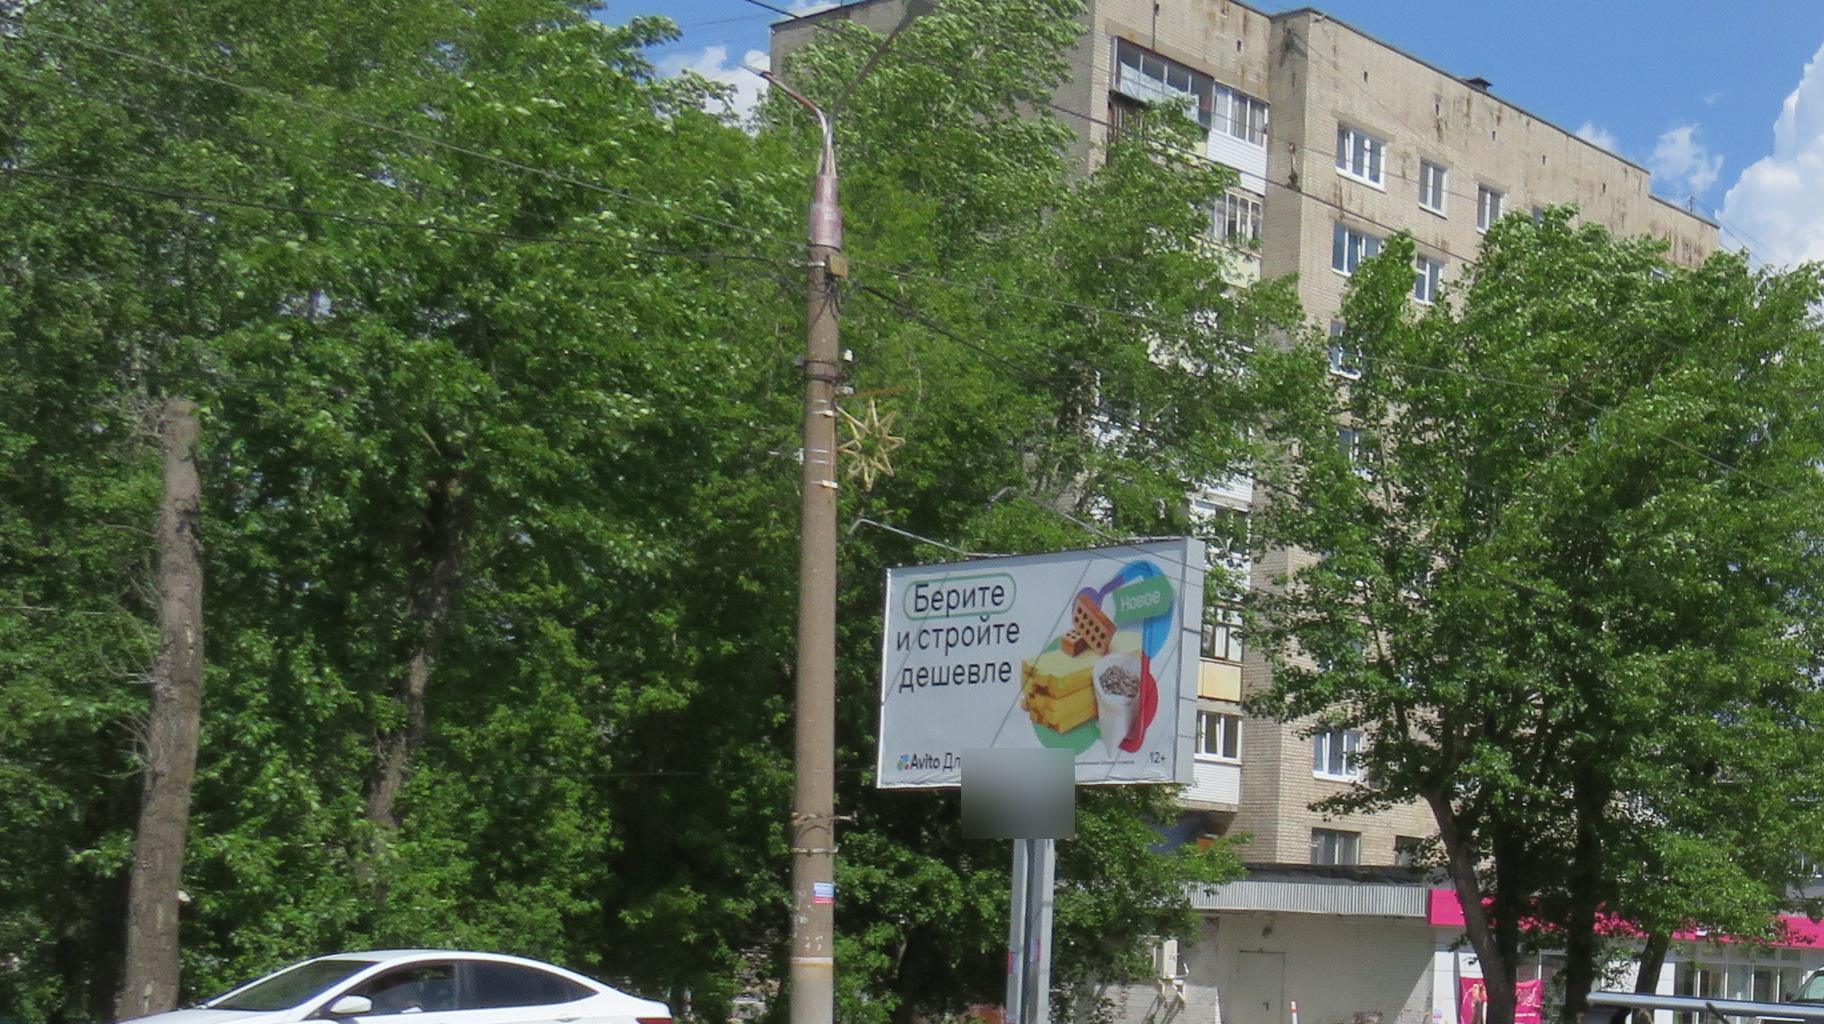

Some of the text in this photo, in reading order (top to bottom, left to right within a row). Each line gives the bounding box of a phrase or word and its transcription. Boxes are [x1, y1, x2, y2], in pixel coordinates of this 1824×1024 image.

[914, 582, 1005, 617] Берите
[896, 615, 1021, 655] и стройте
[899, 660, 1012, 693] дешевле
[911, 753, 941, 770] Avito
[1150, 751, 1167, 764] 12+
